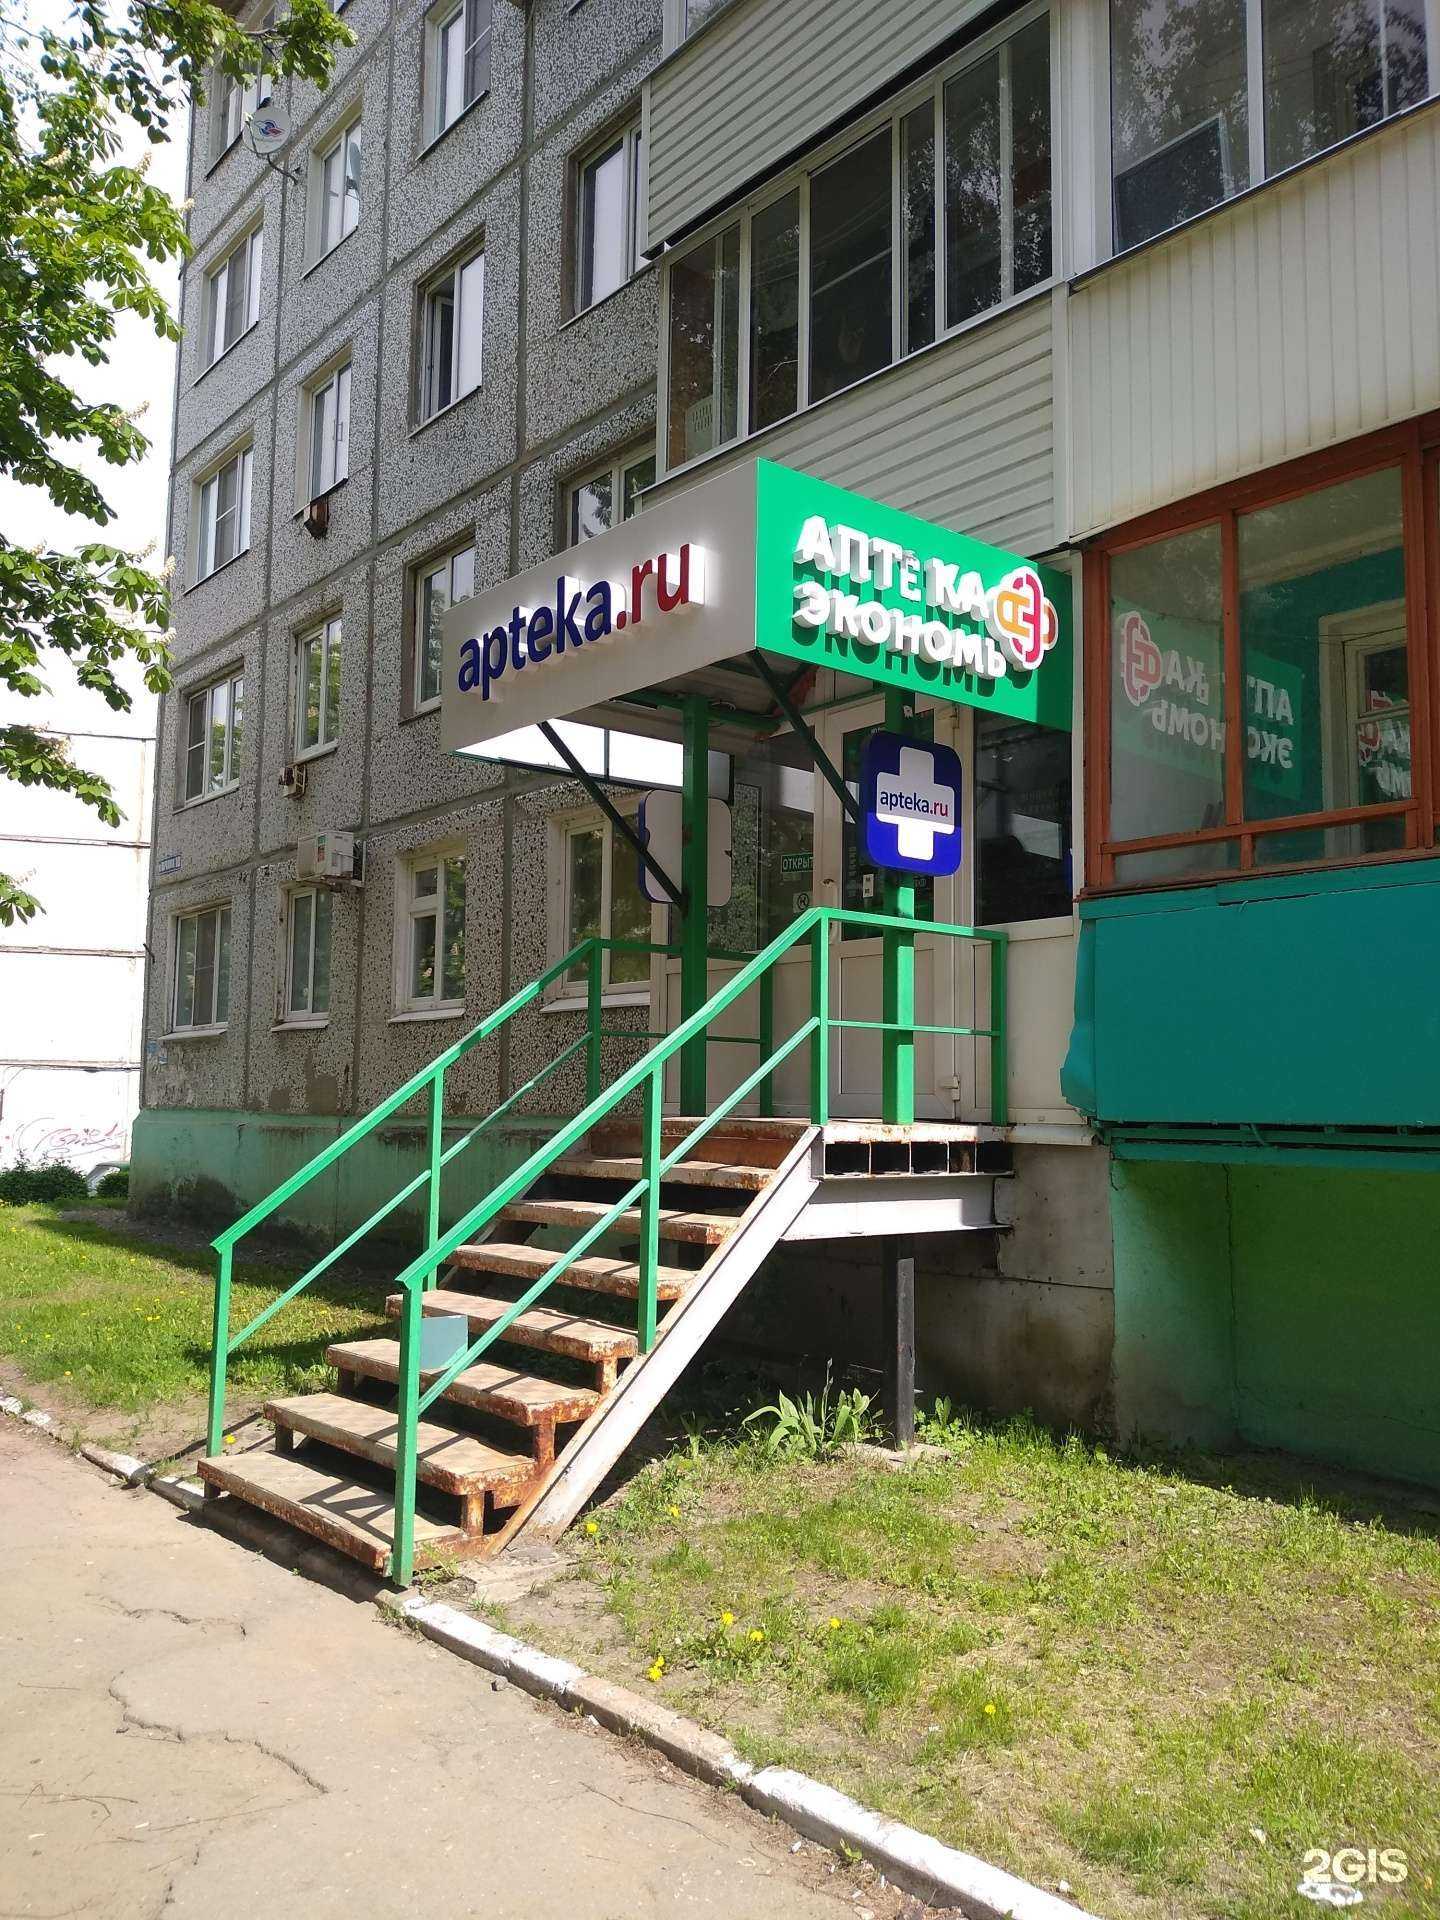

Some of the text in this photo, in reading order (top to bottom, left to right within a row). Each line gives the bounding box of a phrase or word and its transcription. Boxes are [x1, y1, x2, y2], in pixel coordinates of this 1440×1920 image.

[793, 515, 990, 621] АПТЕКА
[458, 543, 698, 701] apteka.ru
[793, 580, 1007, 680] ЭКОНОМЬ
[880, 791, 948, 816] apteka.ru
